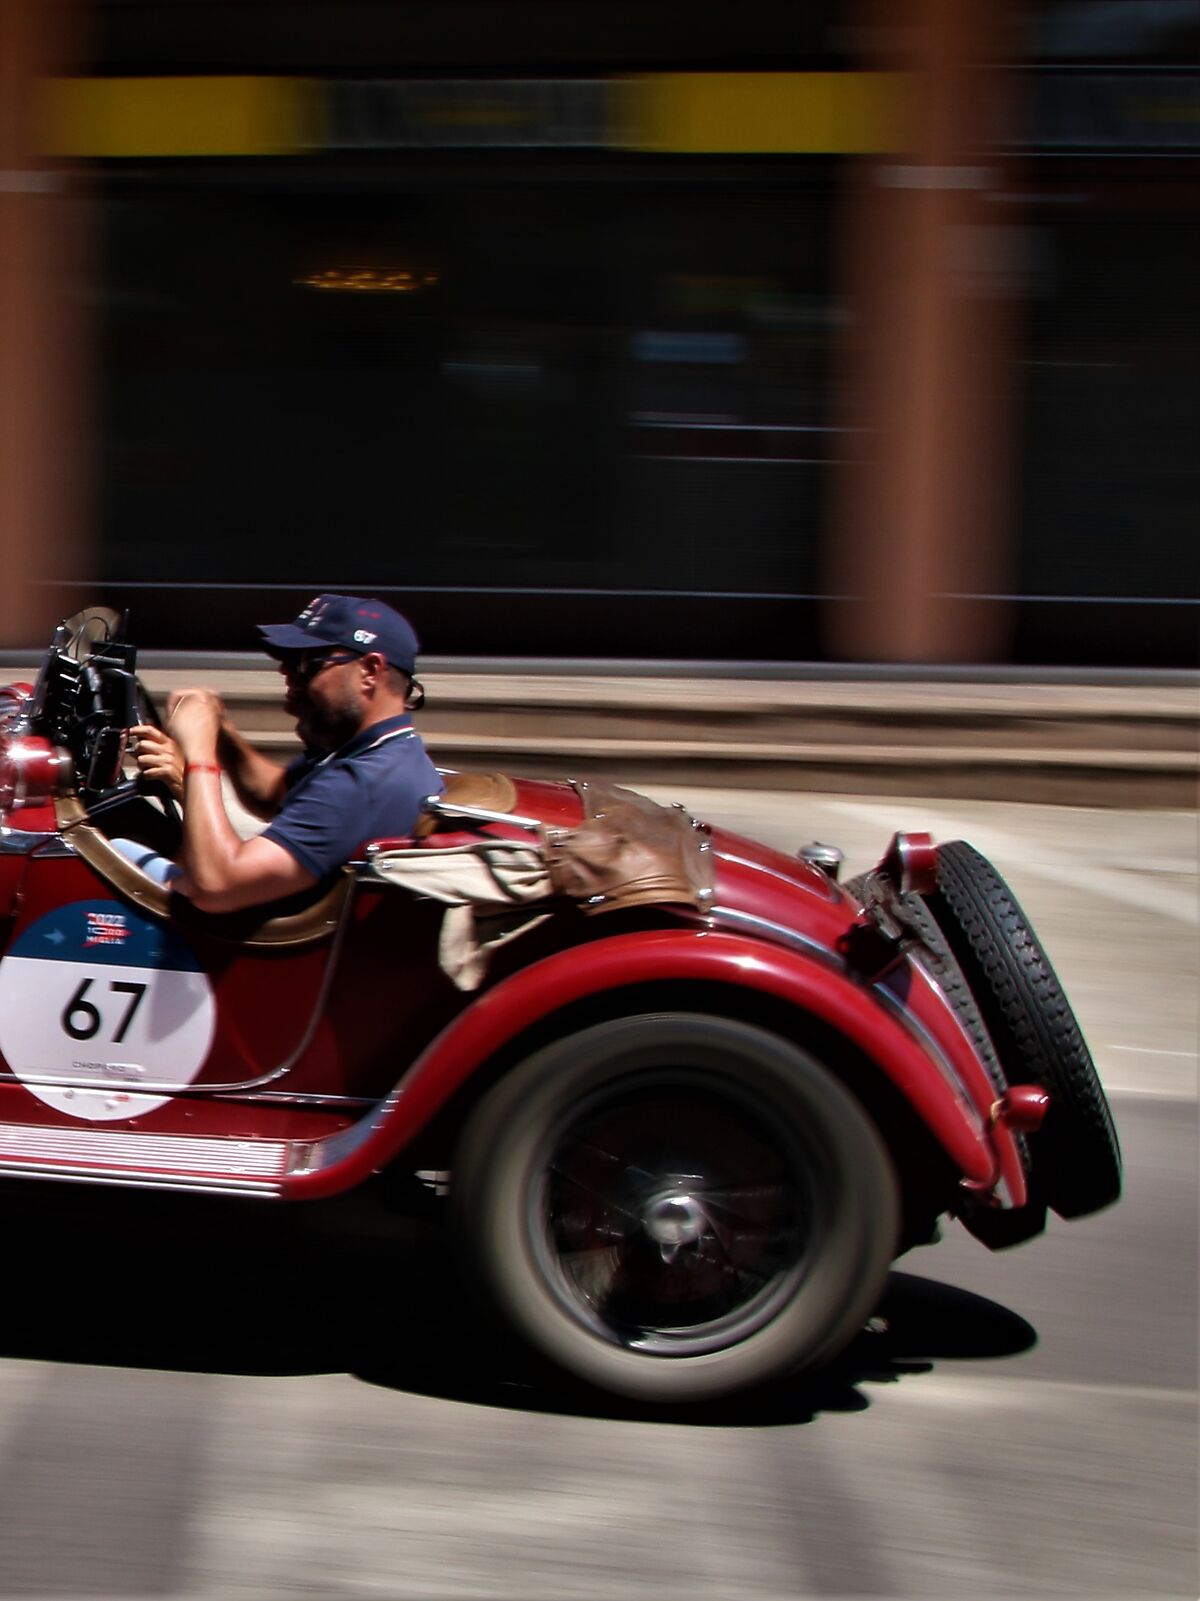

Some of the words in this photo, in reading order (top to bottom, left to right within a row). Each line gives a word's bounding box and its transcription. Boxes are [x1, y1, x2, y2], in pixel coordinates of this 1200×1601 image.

[353, 629, 378, 644] 67
[87, 912, 127, 928] 2022
[61, 977, 148, 1043] 67
